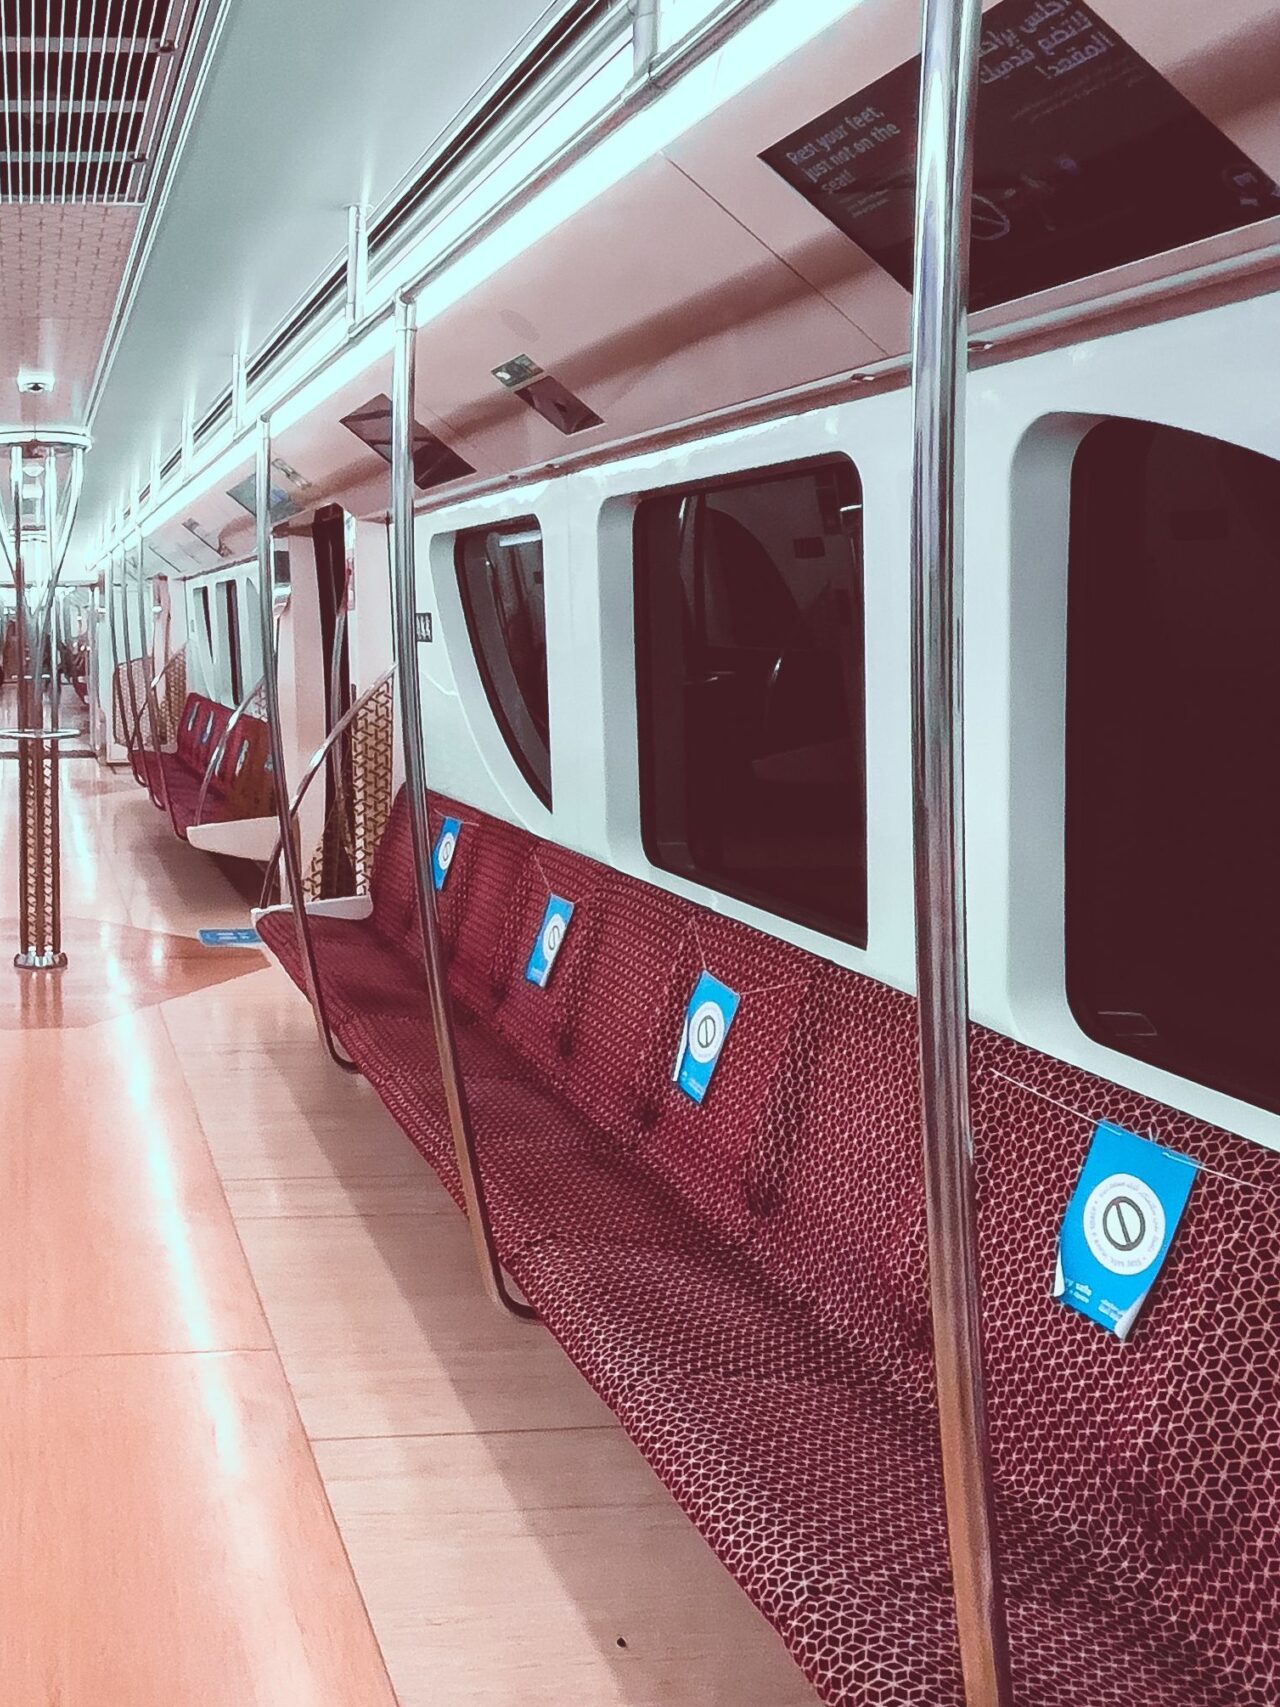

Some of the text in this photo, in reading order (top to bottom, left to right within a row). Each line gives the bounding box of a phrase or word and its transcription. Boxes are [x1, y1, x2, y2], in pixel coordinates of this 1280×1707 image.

[785, 106, 885, 166] Rest your feet,
[801, 123, 900, 183] just not on the
